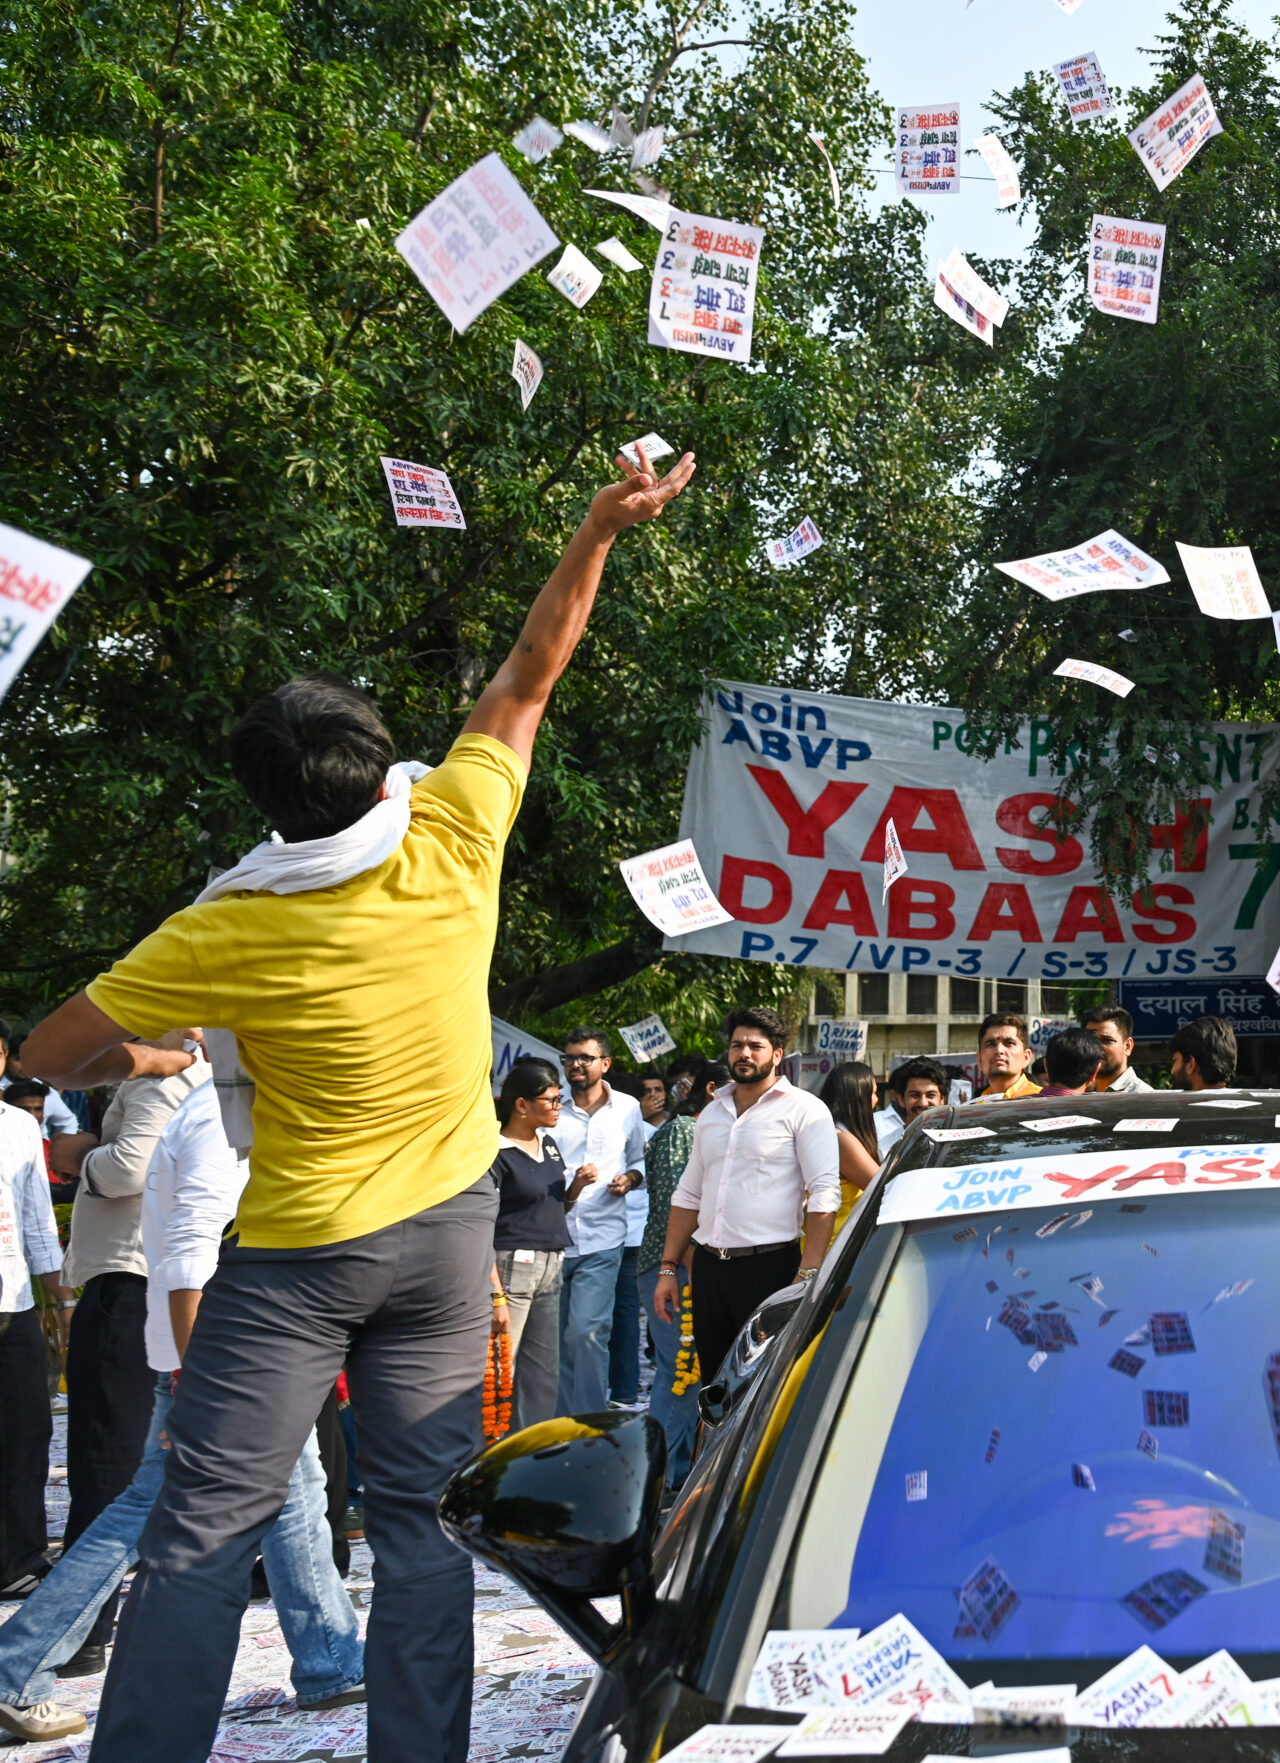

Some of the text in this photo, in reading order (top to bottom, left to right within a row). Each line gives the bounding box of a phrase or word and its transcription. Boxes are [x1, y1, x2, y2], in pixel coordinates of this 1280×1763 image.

[900, 114, 907, 128] 3
[900, 134, 908, 146] 3
[901, 151, 909, 164] 3
[901, 166, 908, 178] 7
[666, 221, 680, 242] 3
[691, 226, 714, 254] सिंह
[661, 251, 675, 270] 3
[660, 277, 673, 298] 3
[723, 263, 749, 290] रिया
[660, 302, 670, 320] 7
[721, 317, 744, 335] यश
[438, 480, 445, 488] 7
[442, 489, 451, 498] 3
[448, 501, 456, 509] 3
[453, 513, 461, 523] 3
[717, 691, 827, 731] Join
[721, 719, 873, 770] ABVP
[745, 763, 1212, 876] YASH
[718, 854, 1197, 943] DABAAS
[740, 931, 818, 964] P.7
[1136, 995, 1208, 1015] दयाल
[1216, 988, 1265, 1015] सिंह
[820, 1022, 830, 1049] 3
[1031, 1019, 1041, 1045] 3
[942, 1166, 1024, 1190] JOIN
[936, 1184, 1032, 1212] ABVP
[788, 1652, 815, 1698] YASH
[866, 1649, 922, 1688] YASH
[841, 1673, 863, 1697] 7
[1094, 1682, 1149, 1722] YASH
[1150, 1674, 1173, 1697] 7
